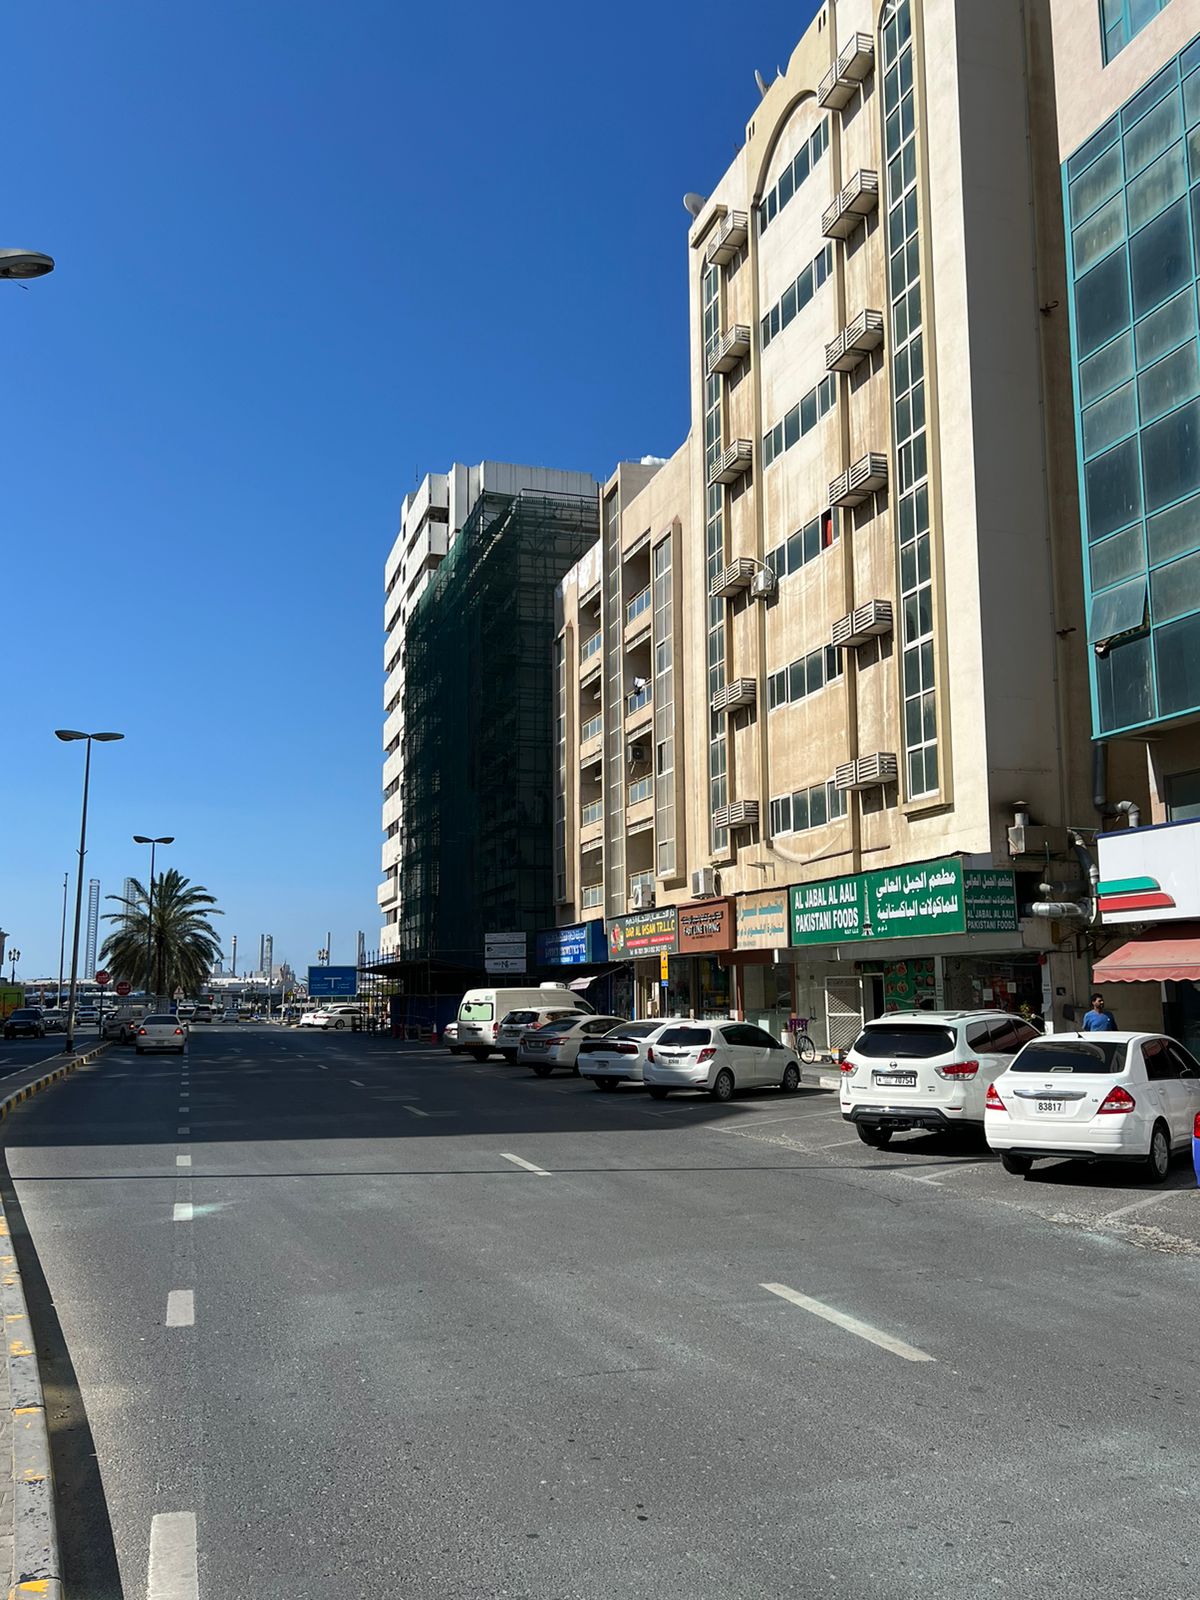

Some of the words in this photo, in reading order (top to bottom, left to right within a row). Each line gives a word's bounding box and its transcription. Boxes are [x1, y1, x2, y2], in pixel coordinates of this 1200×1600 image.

[875, 875, 902, 900] العالي
[902, 872, 927, 894] الجبل
[928, 869, 957, 892] مطعم
[795, 891, 804, 910] AL
[804, 887, 827, 908] JABAL
[828, 885, 839, 905] AL
[839, 882, 857, 903] AALI
[919, 895, 958, 919] للماكولات
[795, 911, 832, 933] PAKISTANI
[832, 907, 859, 929] FOODS
[876, 899, 918, 923] الباكستانية
[967, 910, 974, 918] AL
[975, 909, 992, 918] JABAL
[994, 909, 1001, 918] AL
[1002, 909, 1015, 918] AALI
[967, 920, 997, 930] PAKISTANI
[997, 920, 1016, 930] FOODS
[1038, 1102, 1062, 1111] 83817
